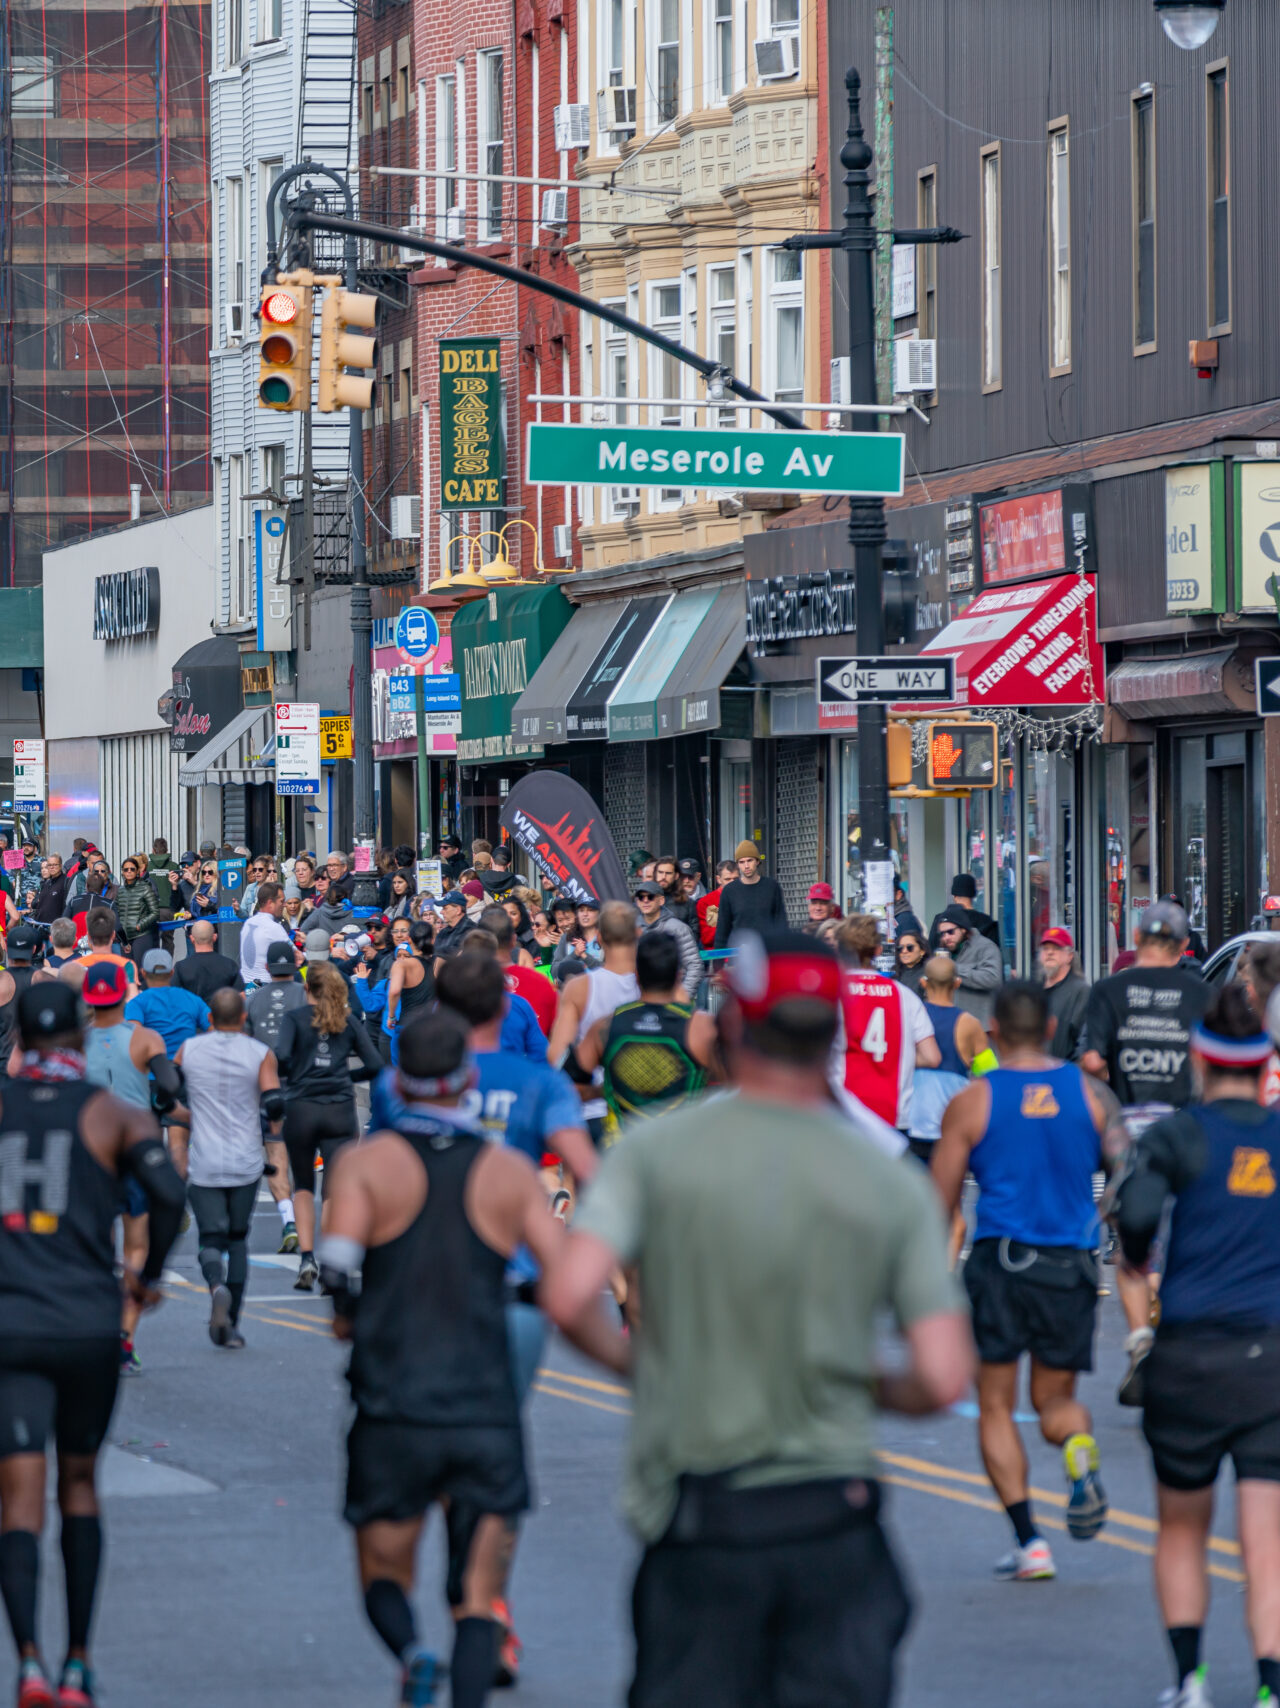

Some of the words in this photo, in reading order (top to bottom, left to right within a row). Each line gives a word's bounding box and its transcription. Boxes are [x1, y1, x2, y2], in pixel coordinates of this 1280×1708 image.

[441, 350, 499, 374] DELI
[452, 377, 490, 475] BAGELS
[598, 440, 764, 475] Meserole
[783, 446, 834, 477] Av
[444, 478, 500, 502] CAFE
[268, 541, 285, 619] CHASE
[93, 567, 153, 640] ASSOCIATED
[971, 633, 1036, 695] EYEBROWS
[1028, 578, 1095, 641] THREADING
[1024, 631, 1075, 677] WAXING
[391, 680, 409, 692] B43
[425, 677, 449, 685] Greenpoint
[463, 642, 499, 700] BAKER'S
[841, 672, 878, 688] ONE
[896, 671, 937, 687] WAY
[1043, 652, 1090, 694] FACIAL
[392, 696, 410, 709] B62
[450, 694, 459, 702] City
[320, 719, 350, 733] COPIES
[278, 785, 304, 793] 310276
[513, 810, 540, 843] WE
[536, 842, 571, 882] ARE
[514, 831, 561, 885] RUNNING
[227, 871, 238, 888] P
[861, 1006, 888, 1062] 4
[1119, 1047, 1187, 1073] CCNY
